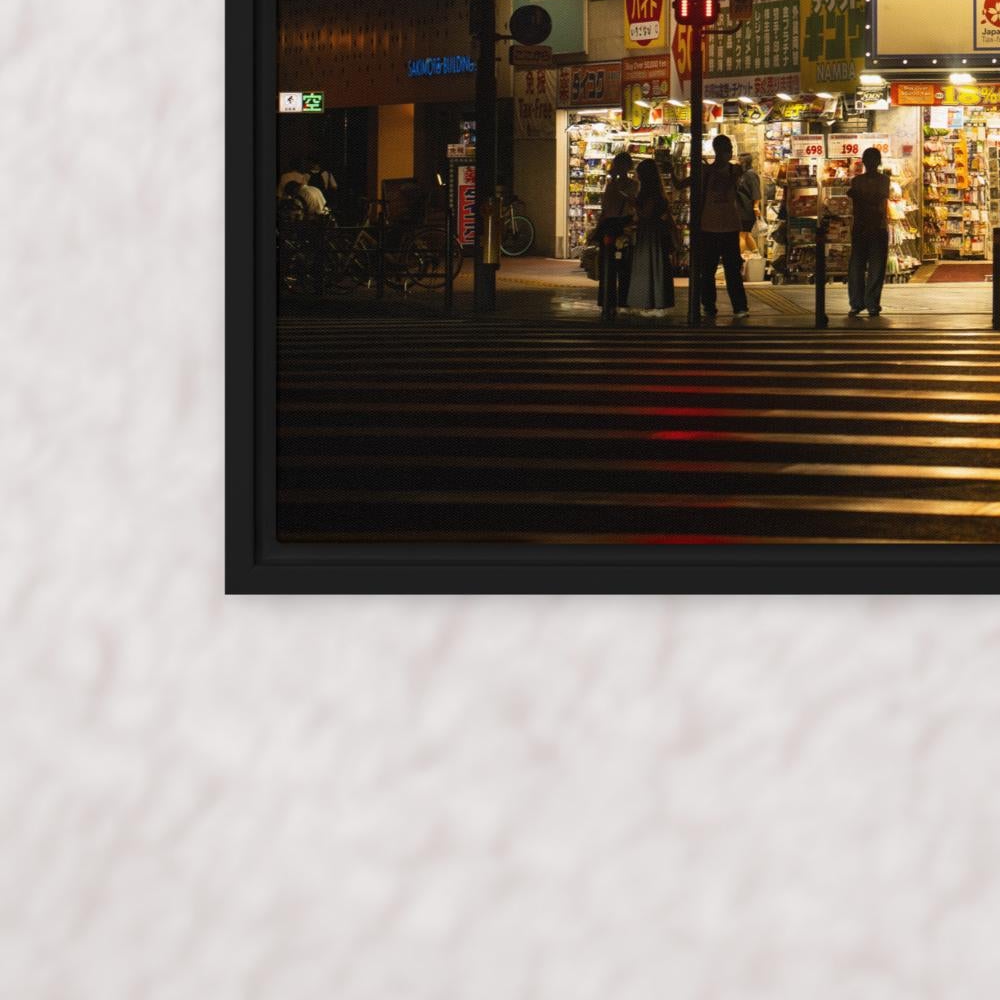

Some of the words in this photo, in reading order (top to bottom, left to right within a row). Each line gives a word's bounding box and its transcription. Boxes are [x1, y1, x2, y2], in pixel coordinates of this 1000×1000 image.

[816, 59, 856, 82] NAMBA
[302, 92, 322, 112] 空
[805, 145, 823, 155] 698
[841, 143, 859, 155] 198
